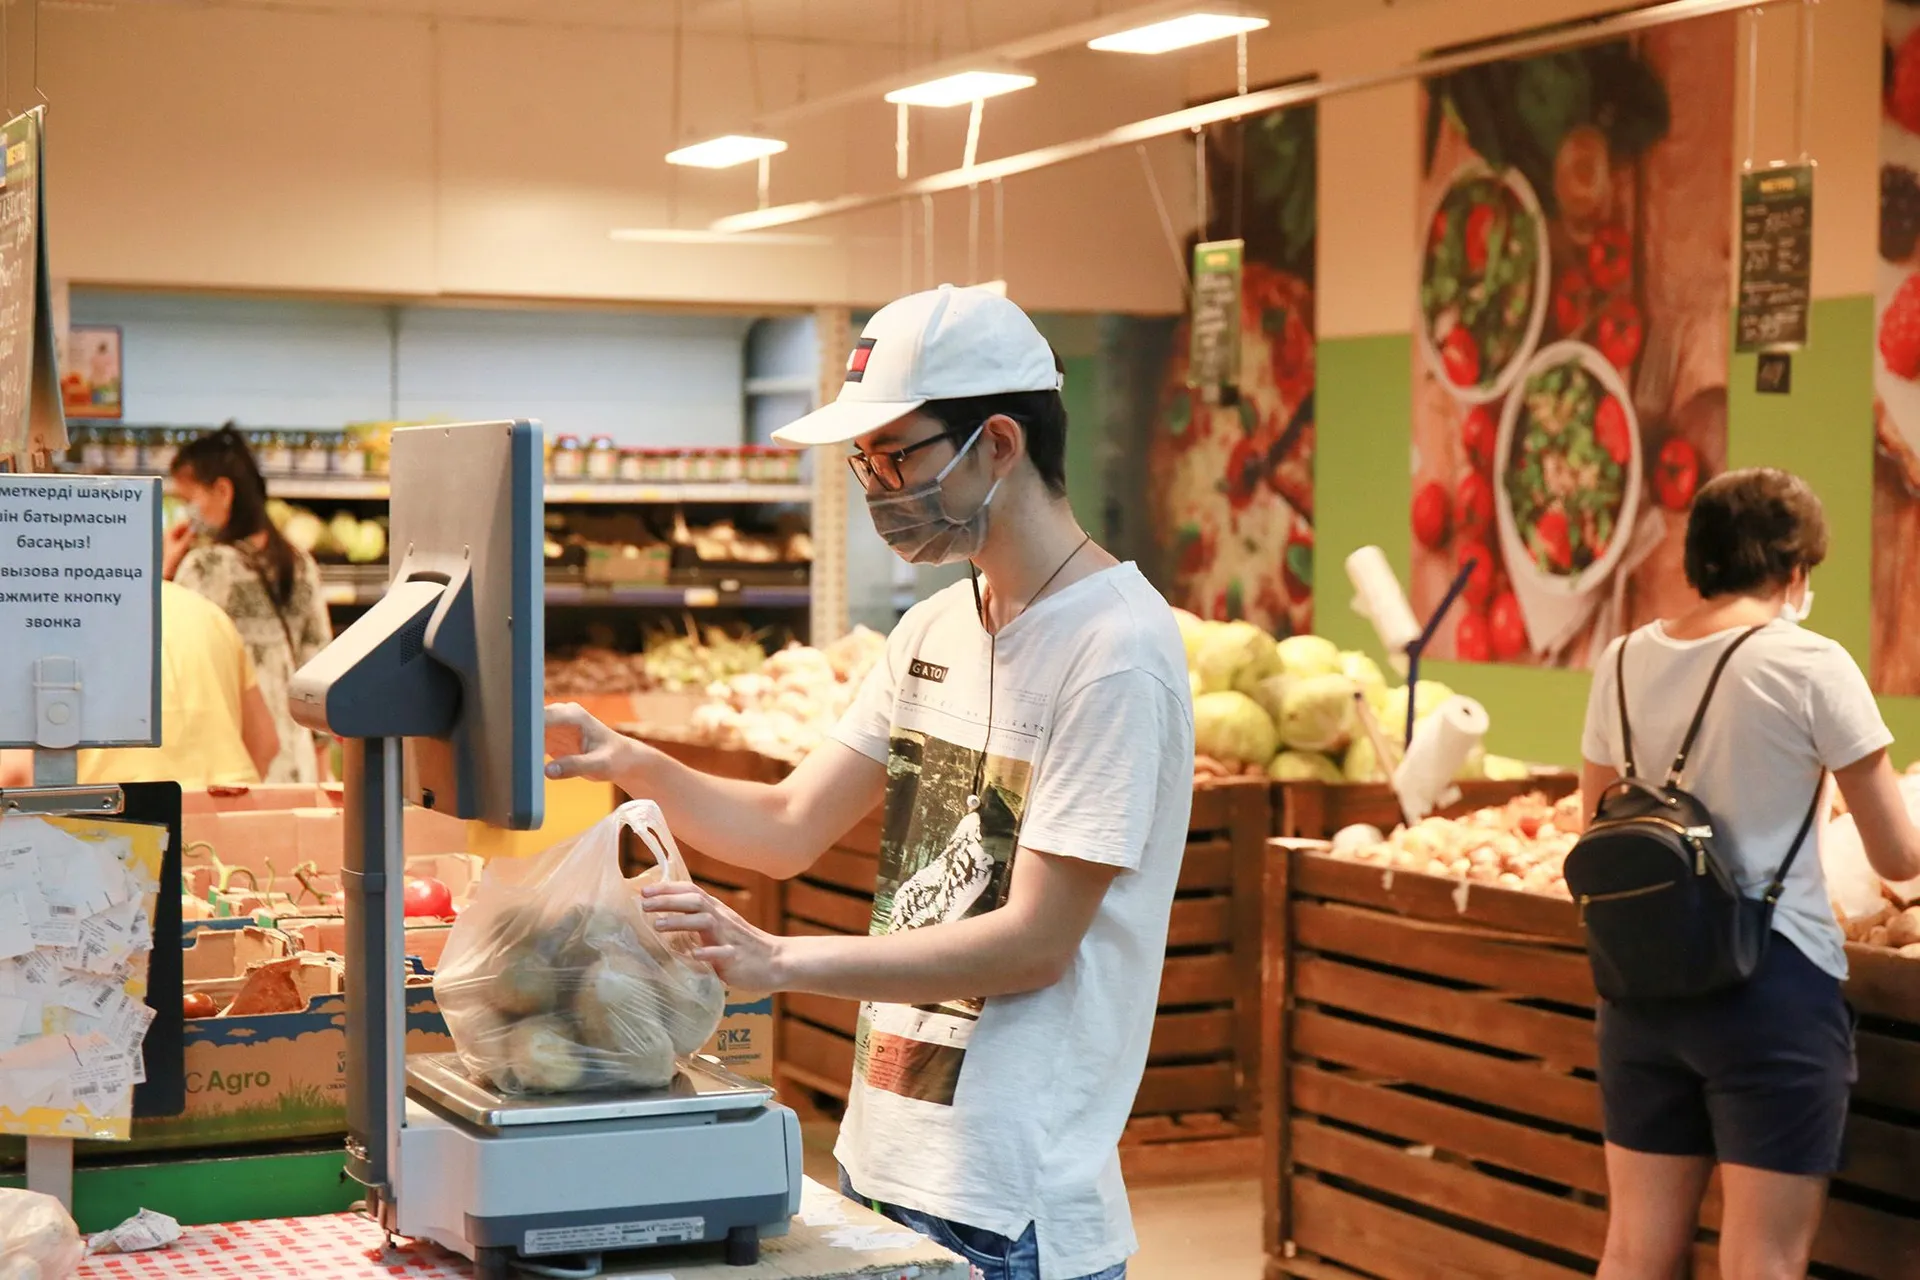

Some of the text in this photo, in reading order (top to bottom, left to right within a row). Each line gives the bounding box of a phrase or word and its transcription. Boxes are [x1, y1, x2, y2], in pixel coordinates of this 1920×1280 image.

[77, 488, 143, 502] шақыру
[0, 509, 126, 526] ін батырмасын
[17, 535, 91, 551] басаңыз!
[1, 567, 143, 581] вызова продавца
[64, 592, 122, 606] кнопку
[25, 617, 81, 628] звонка
